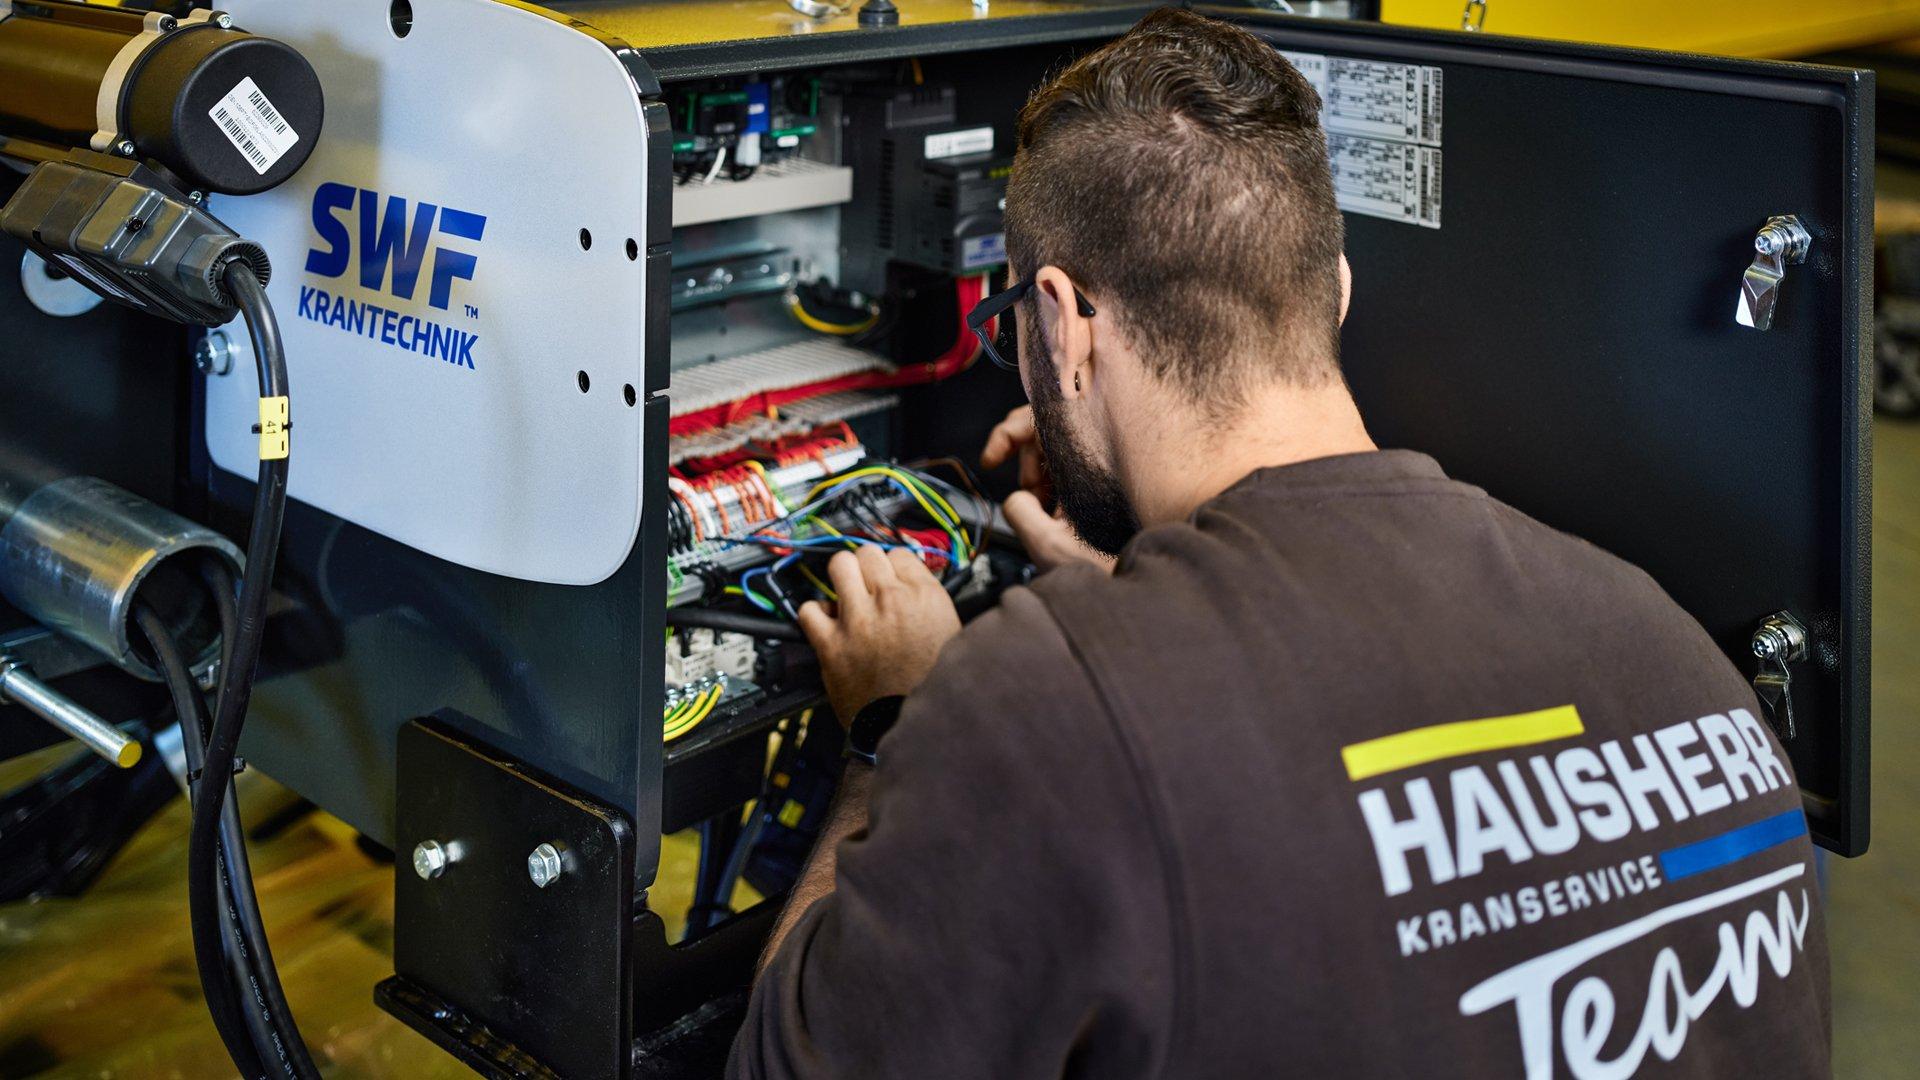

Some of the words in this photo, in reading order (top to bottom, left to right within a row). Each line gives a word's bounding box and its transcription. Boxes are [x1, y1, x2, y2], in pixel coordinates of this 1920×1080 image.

[305, 182, 487, 310] SWF
[298, 285, 479, 370] KRANTECHNIK
[266, 420, 277, 435] 41
[1358, 708, 1792, 897] HAUSHERR
[1396, 854, 1663, 957] KRANSERVICE
[1458, 863, 1810, 1080] Team
